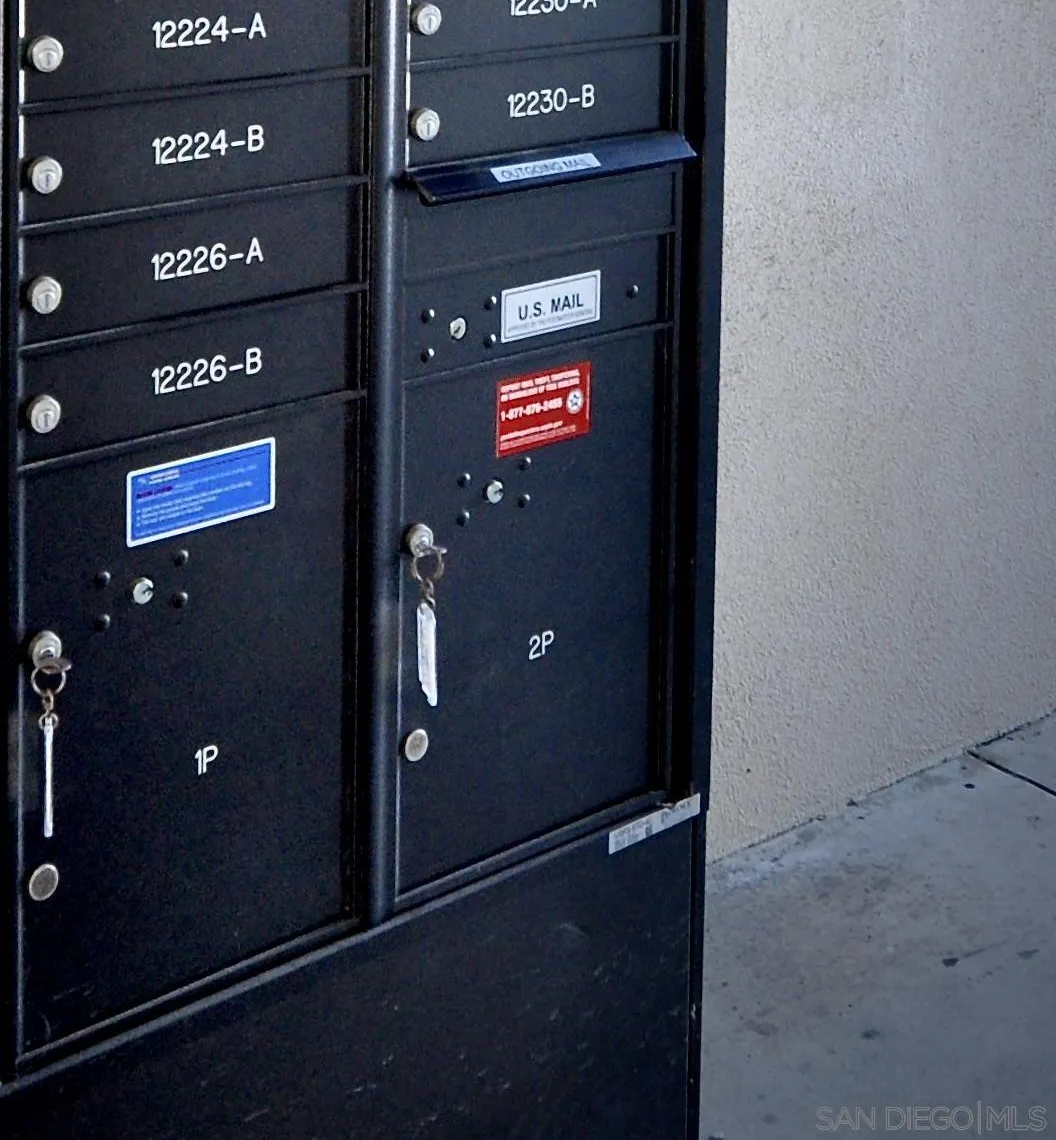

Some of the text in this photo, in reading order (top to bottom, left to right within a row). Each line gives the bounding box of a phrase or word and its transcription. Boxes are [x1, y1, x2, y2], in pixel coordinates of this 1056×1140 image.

[151, 11, 267, 49] 12224-A
[506, 83, 595, 118] 12230-B
[151, 124, 265, 165] 12224-B
[500, 161, 563, 180] OUTGOING
[150, 236, 264, 281] 12226-A
[518, 301, 546, 321] U.S.
[550, 293, 584, 314] MAIL
[151, 346, 263, 395] 12226-B
[528, 630, 555, 661] 2P
[194, 744, 219, 776] 1P
